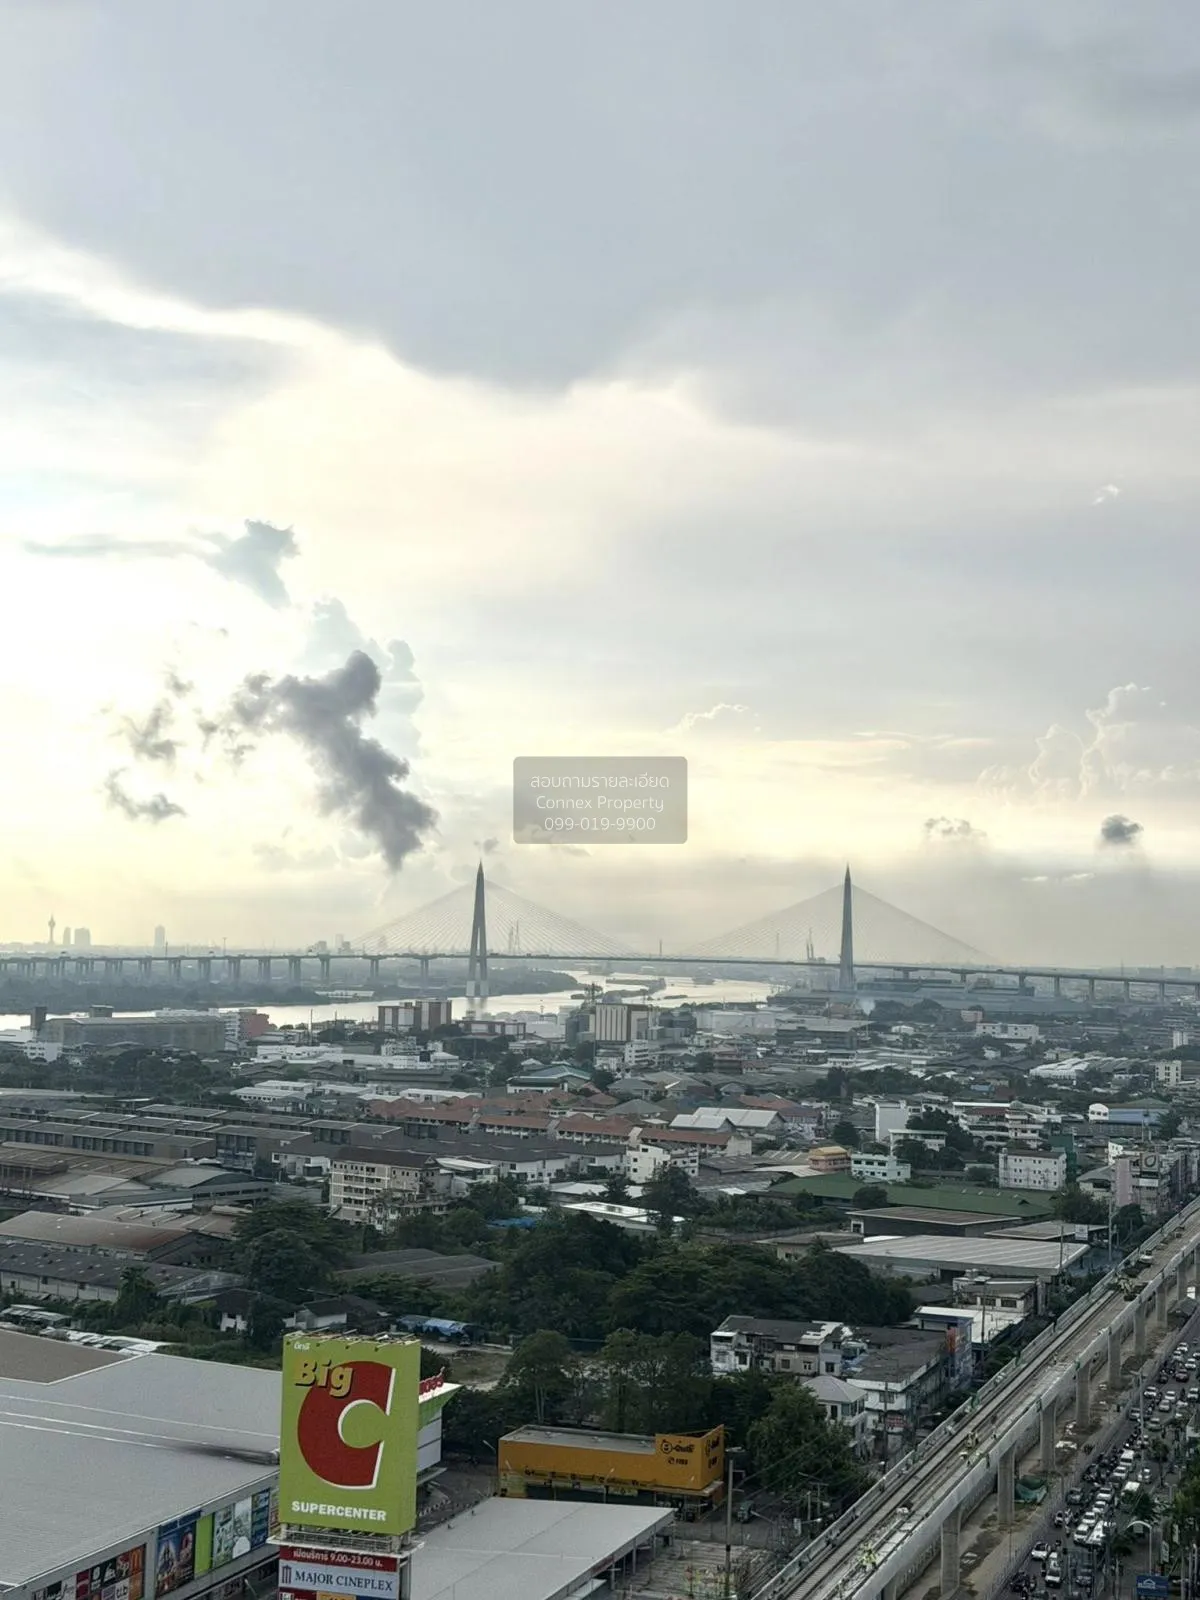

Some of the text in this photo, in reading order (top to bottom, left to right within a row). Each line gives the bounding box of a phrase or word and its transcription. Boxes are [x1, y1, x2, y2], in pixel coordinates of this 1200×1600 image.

[295, 1358, 354, 1398] Big
[297, 1360, 396, 1490] C
[291, 1500, 387, 1522] SUPERCENTER
[295, 1570, 393, 1591] MAJOR CINEPLEX
